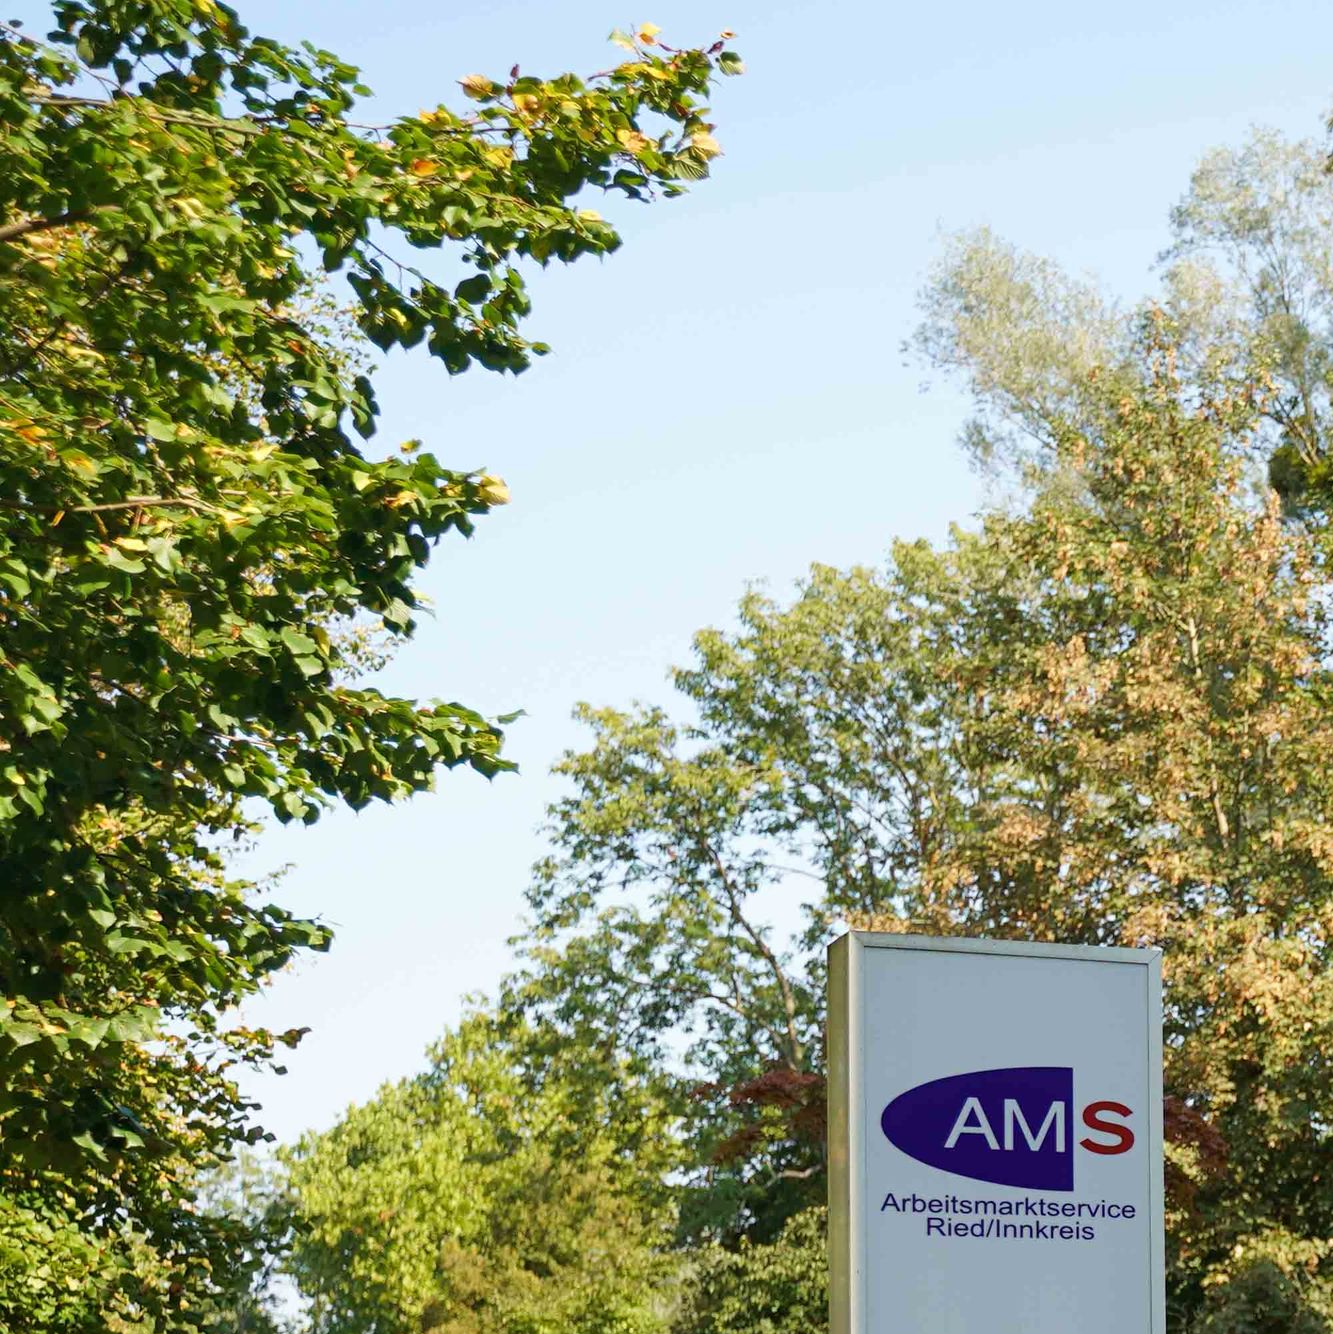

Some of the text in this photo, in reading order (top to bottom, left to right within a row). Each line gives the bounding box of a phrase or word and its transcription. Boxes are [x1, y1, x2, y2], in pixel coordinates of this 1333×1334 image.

[944, 1096, 1135, 1155] AMS
[881, 1192, 1136, 1218] Arbeitsmarktservice
[926, 1217, 1095, 1240] Ried/Innkreis
